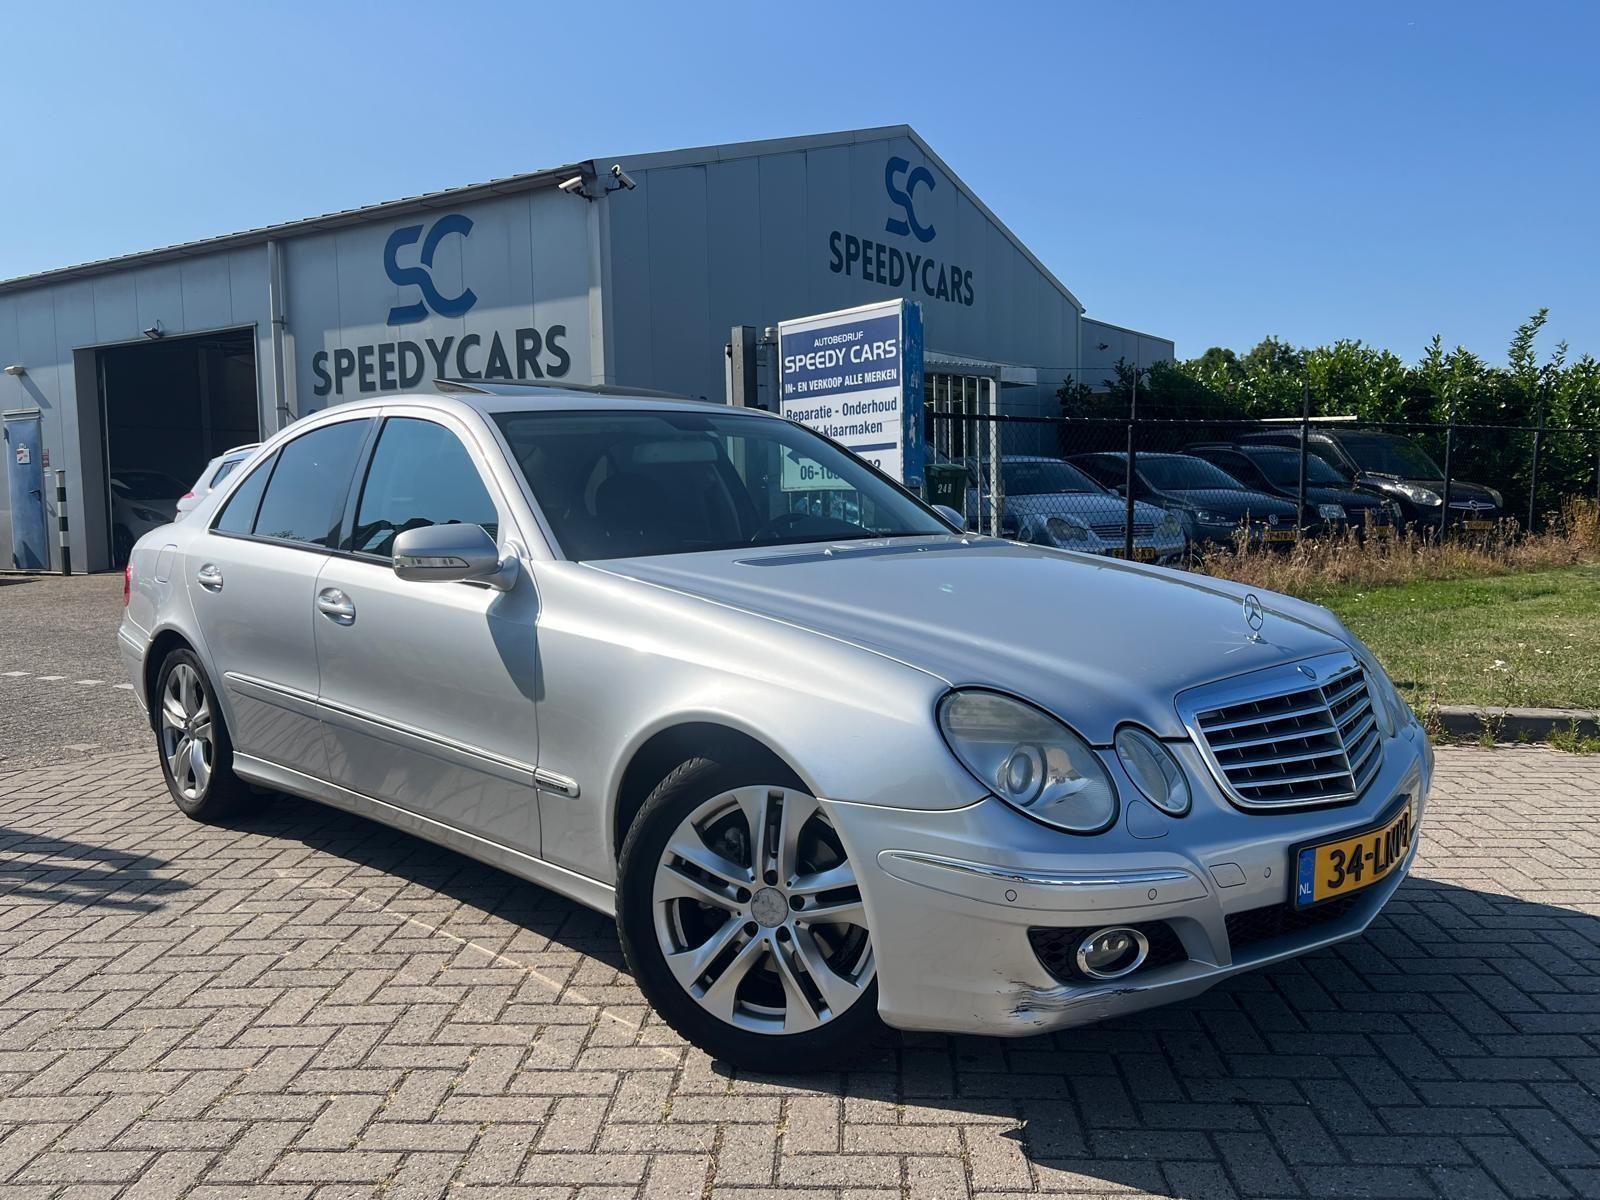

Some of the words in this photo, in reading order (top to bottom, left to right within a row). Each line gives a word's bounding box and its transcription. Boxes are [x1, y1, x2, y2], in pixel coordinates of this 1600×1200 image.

[829, 231, 974, 306] SPEEDYCARS
[814, 331, 864, 347] AUTOBEDRIJF
[313, 325, 571, 396] SPEEDYCARS
[784, 348, 845, 374] SPEEDY
[850, 340, 897, 364] CARS
[785, 383, 796, 394] IN-
[797, 381, 808, 392] EN
[808, 377, 842, 391] VERKOOP
[844, 373, 863, 385] ALLE
[864, 368, 897, 383] MERKEN
[786, 405, 832, 422] Reparatie
[842, 397, 897, 417] Onderhoud
[1299, 884, 1312, 895] NL
